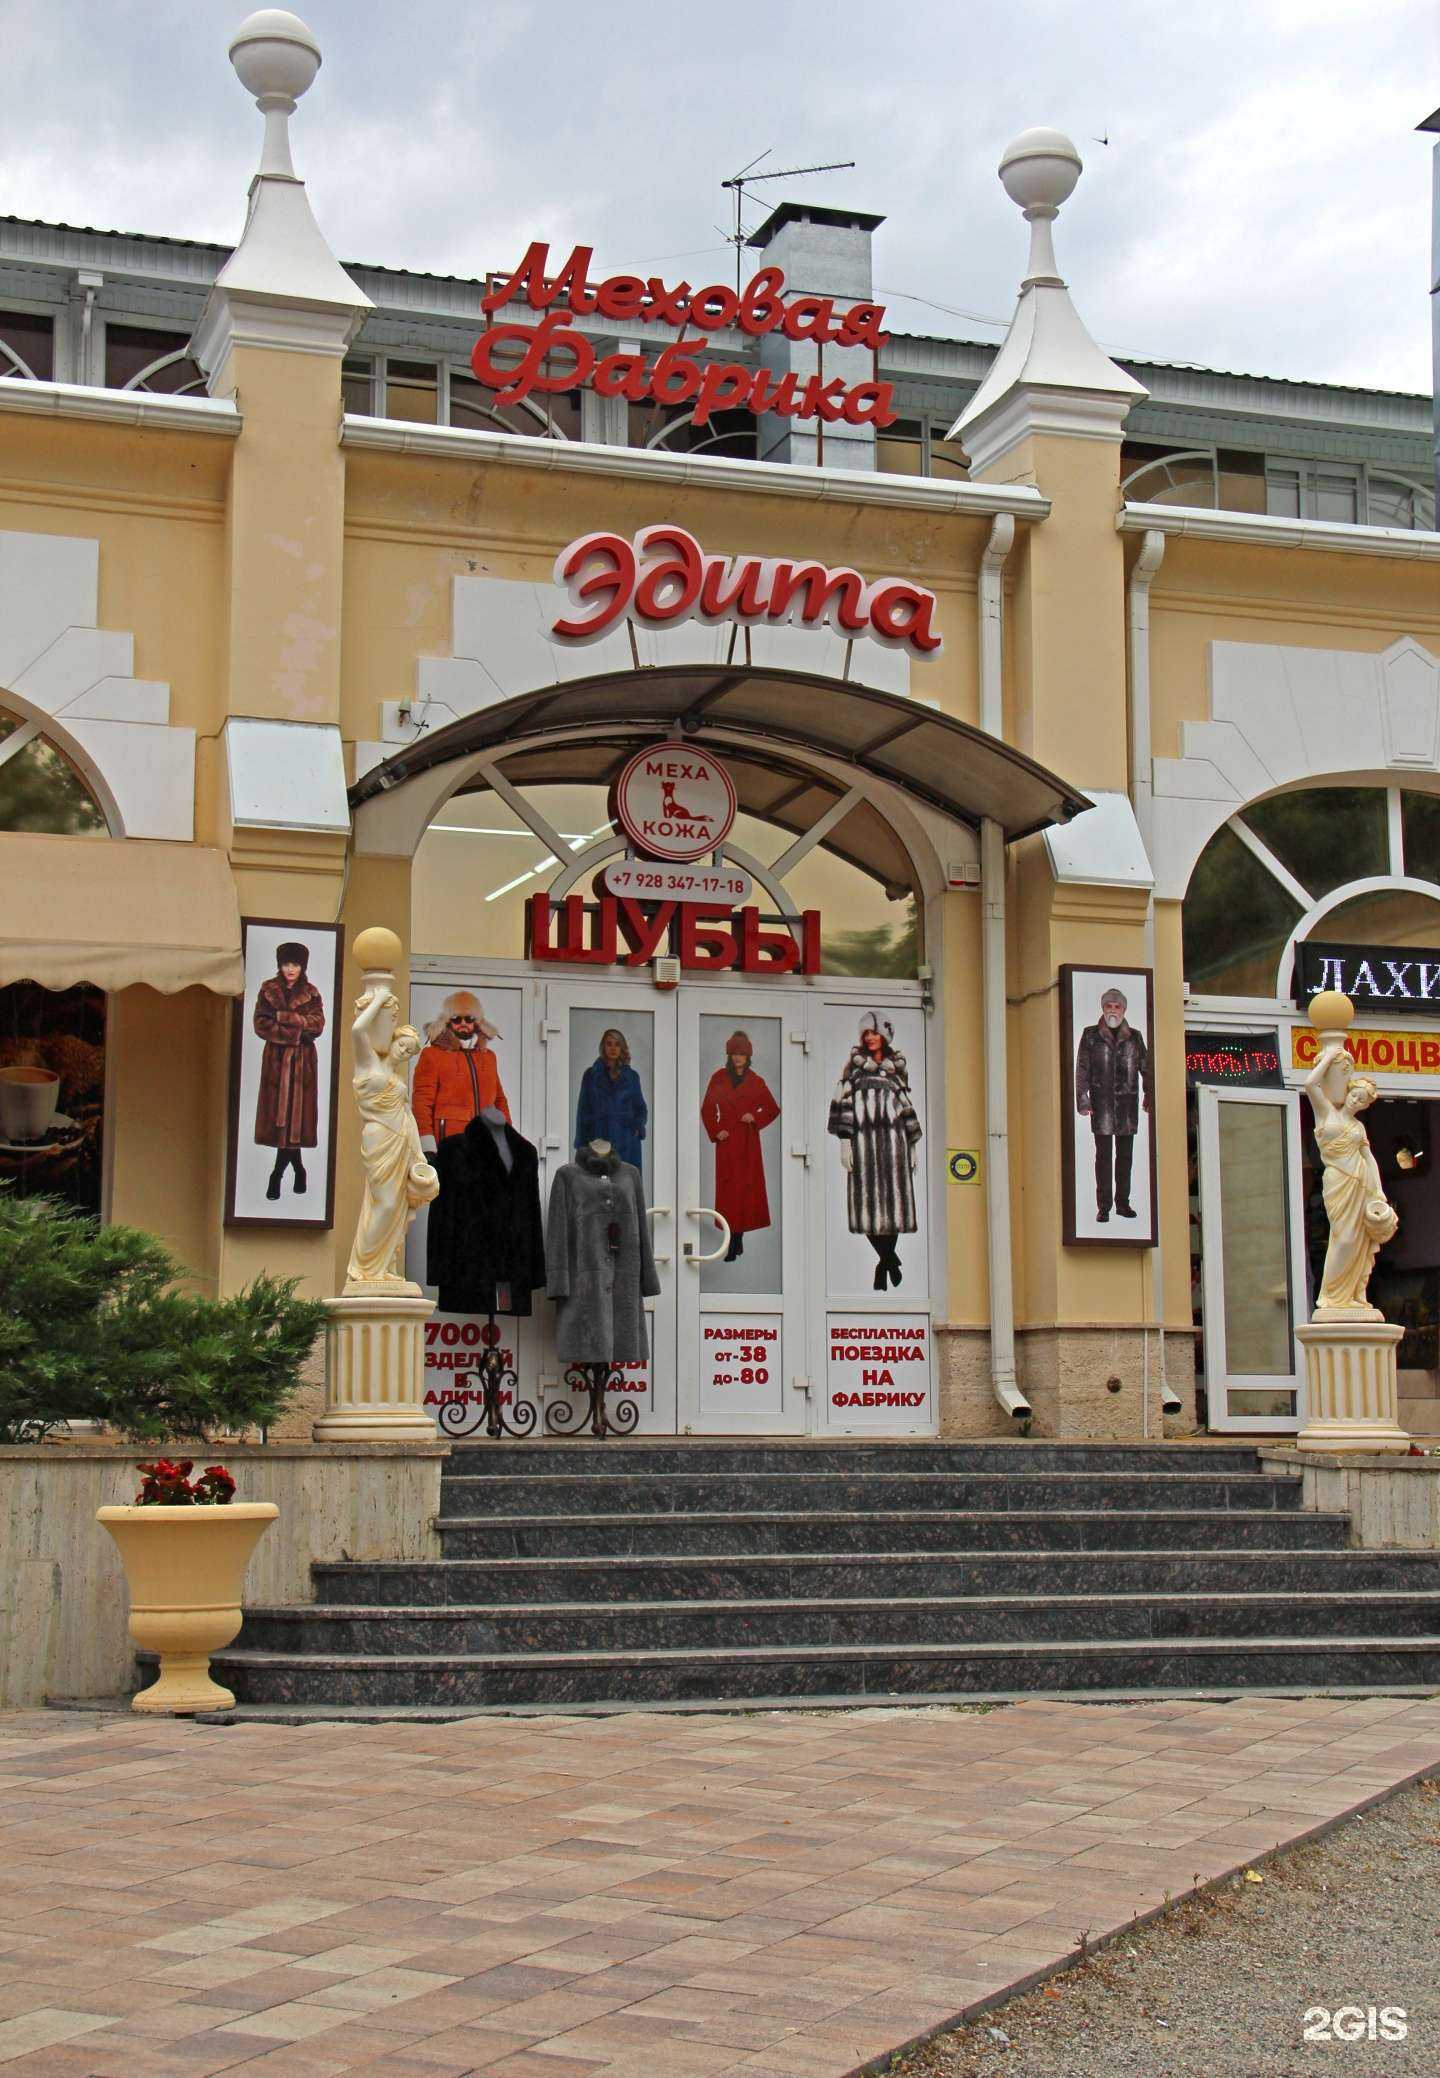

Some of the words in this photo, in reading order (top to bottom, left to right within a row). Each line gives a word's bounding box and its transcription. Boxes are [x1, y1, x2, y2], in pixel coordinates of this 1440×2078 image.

[481, 241, 890, 350] Меховая
[471, 311, 897, 428] Фабрика
[548, 527, 943, 652] Эдита
[645, 761, 710, 781] МЕХА
[642, 820, 712, 841] КОЖА
[613, 872, 631, 886] +7
[636, 874, 662, 888] 928
[667, 875, 744, 894] 347-17-18
[526, 892, 822, 976] ШУБЫ
[1185, 1052, 1278, 1073] ОТКРЫТО
[1295, 1035, 1440, 1072] СМОЦВ
[424, 1322, 501, 1346] 7000
[704, 1328, 778, 1341] РАЗМЕРЫ
[830, 1328, 926, 1341] БЕСПЛАТНАЯ
[830, 1345, 926, 1364] ПОЕЗДКА
[861, 1369, 896, 1386] НА
[831, 1392, 926, 1408] ФАБРИКУ
